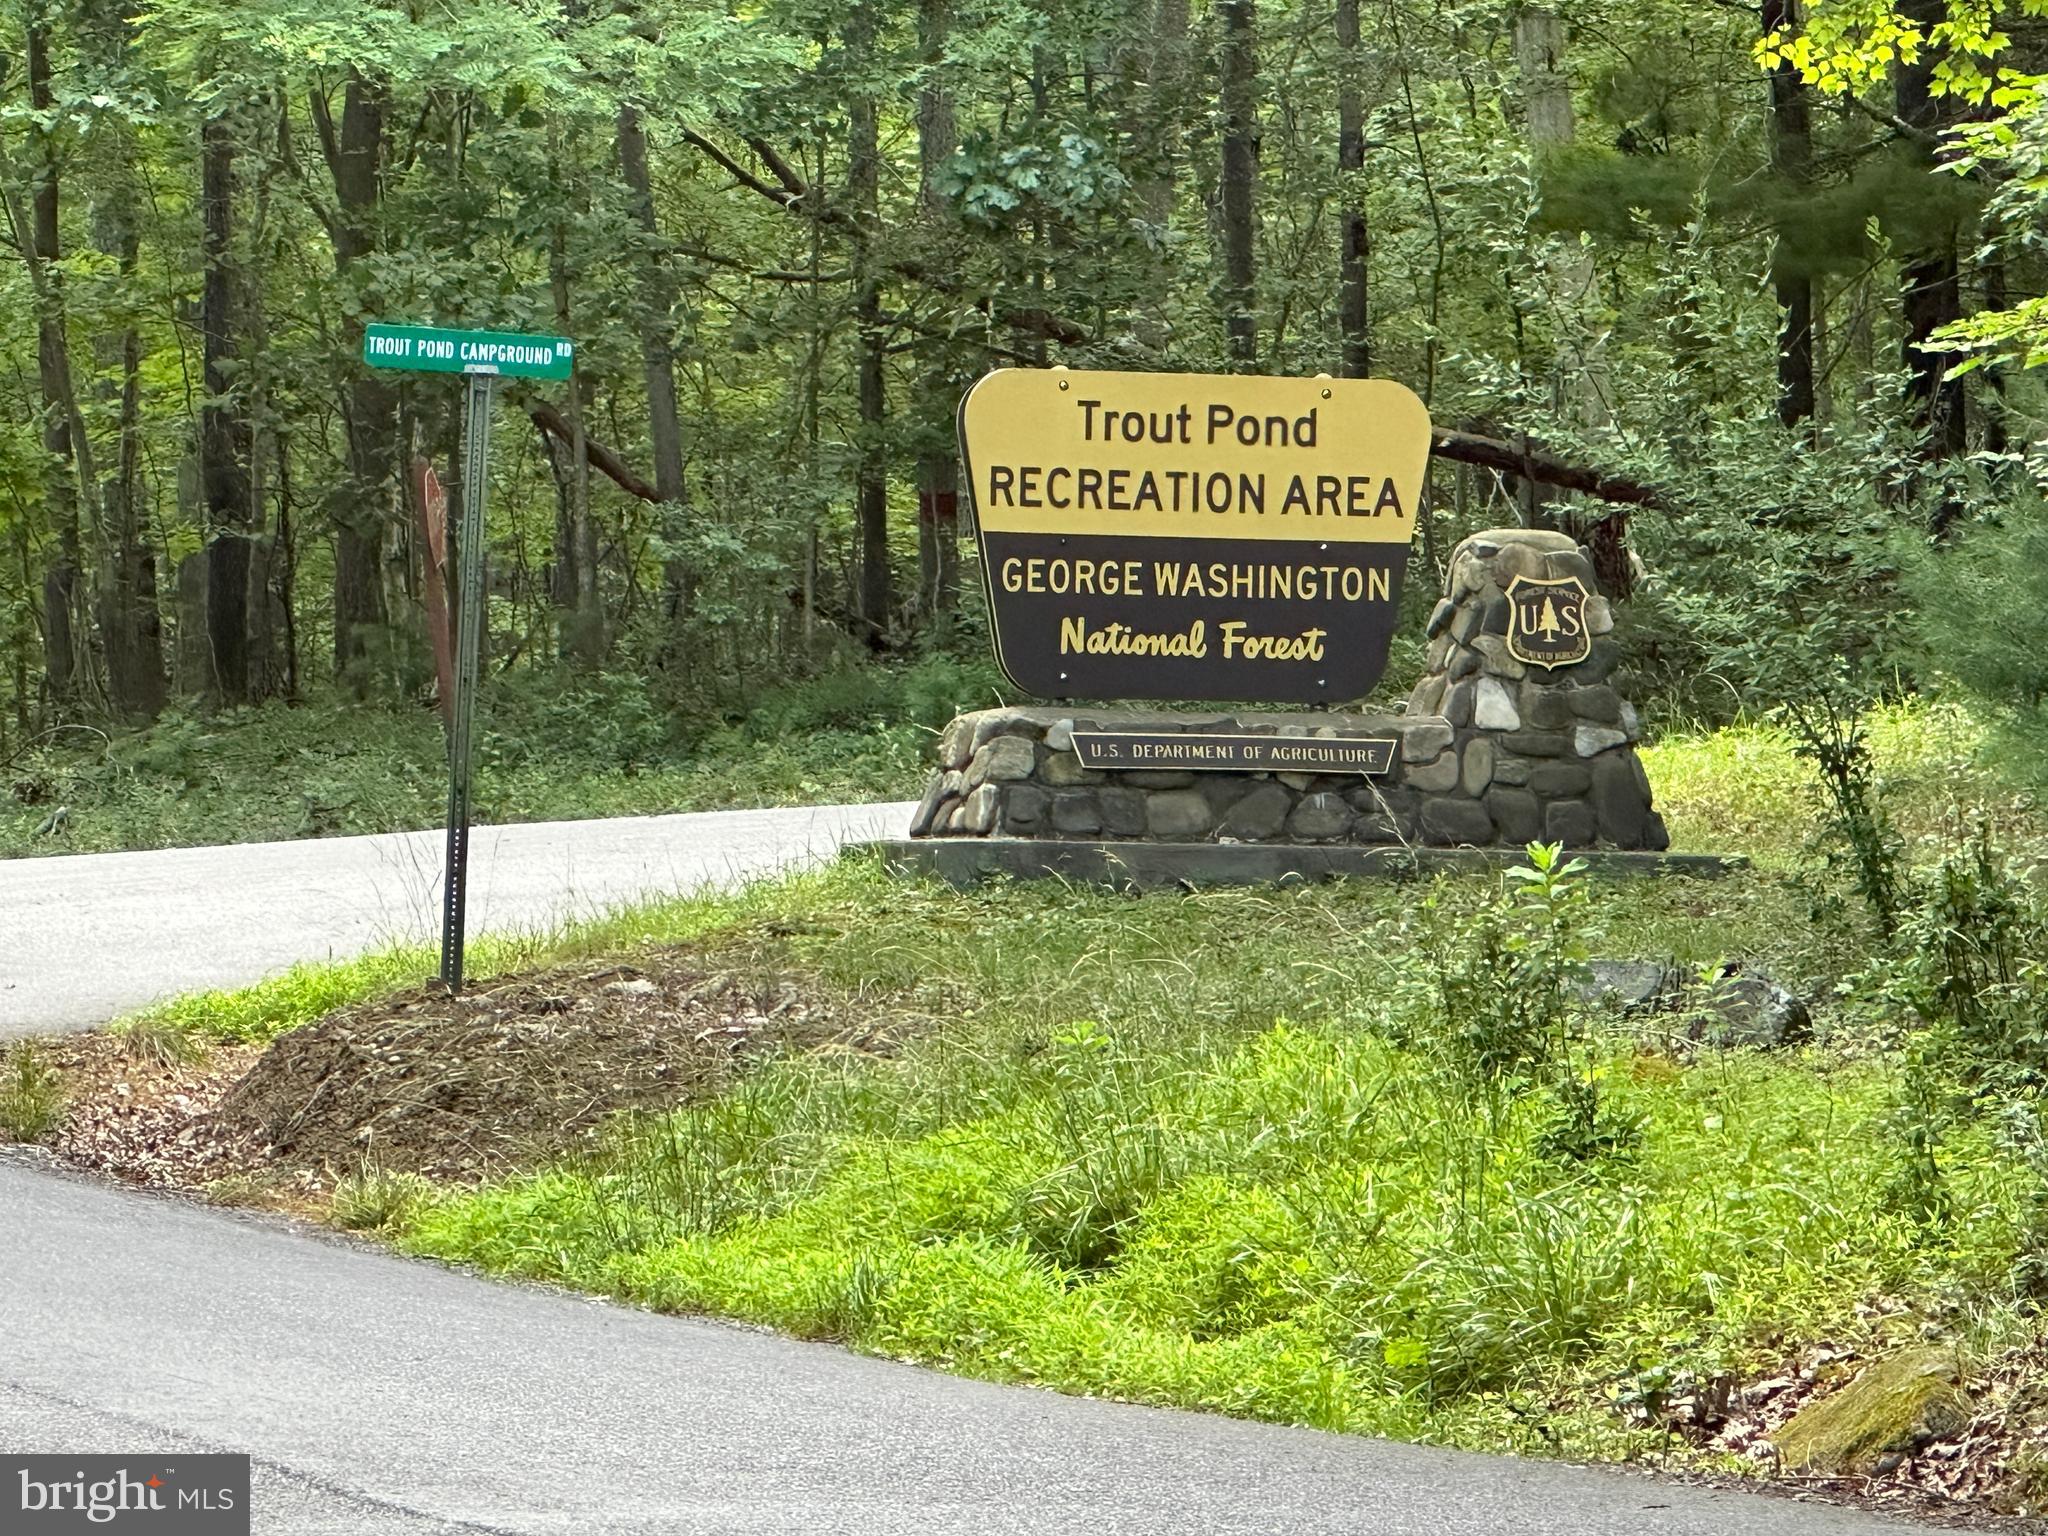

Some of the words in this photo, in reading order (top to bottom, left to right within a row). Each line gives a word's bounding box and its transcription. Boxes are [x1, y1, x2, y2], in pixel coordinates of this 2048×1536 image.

[369, 336, 412, 355] TROUT
[417, 340, 454, 359] POND
[460, 342, 552, 365] CAMPGROUND
[556, 342, 572, 357] RD
[1077, 399, 1192, 445] Trout
[1207, 404, 1318, 447] Pond
[989, 465, 1265, 514] RECREATION
[1280, 475, 1405, 518] AREA
[1001, 557, 1143, 596] GEORGE
[1154, 562, 1391, 602] WASHINGTON
[1060, 616, 1208, 660] National
[1218, 621, 1328, 662] Forest
[1520, 604, 1537, 635] U
[1561, 605, 1580, 636] S
[1090, 743, 1124, 758] U.S.
[1132, 743, 1235, 759] DEPARTMENT
[1243, 745, 1264, 759] OF
